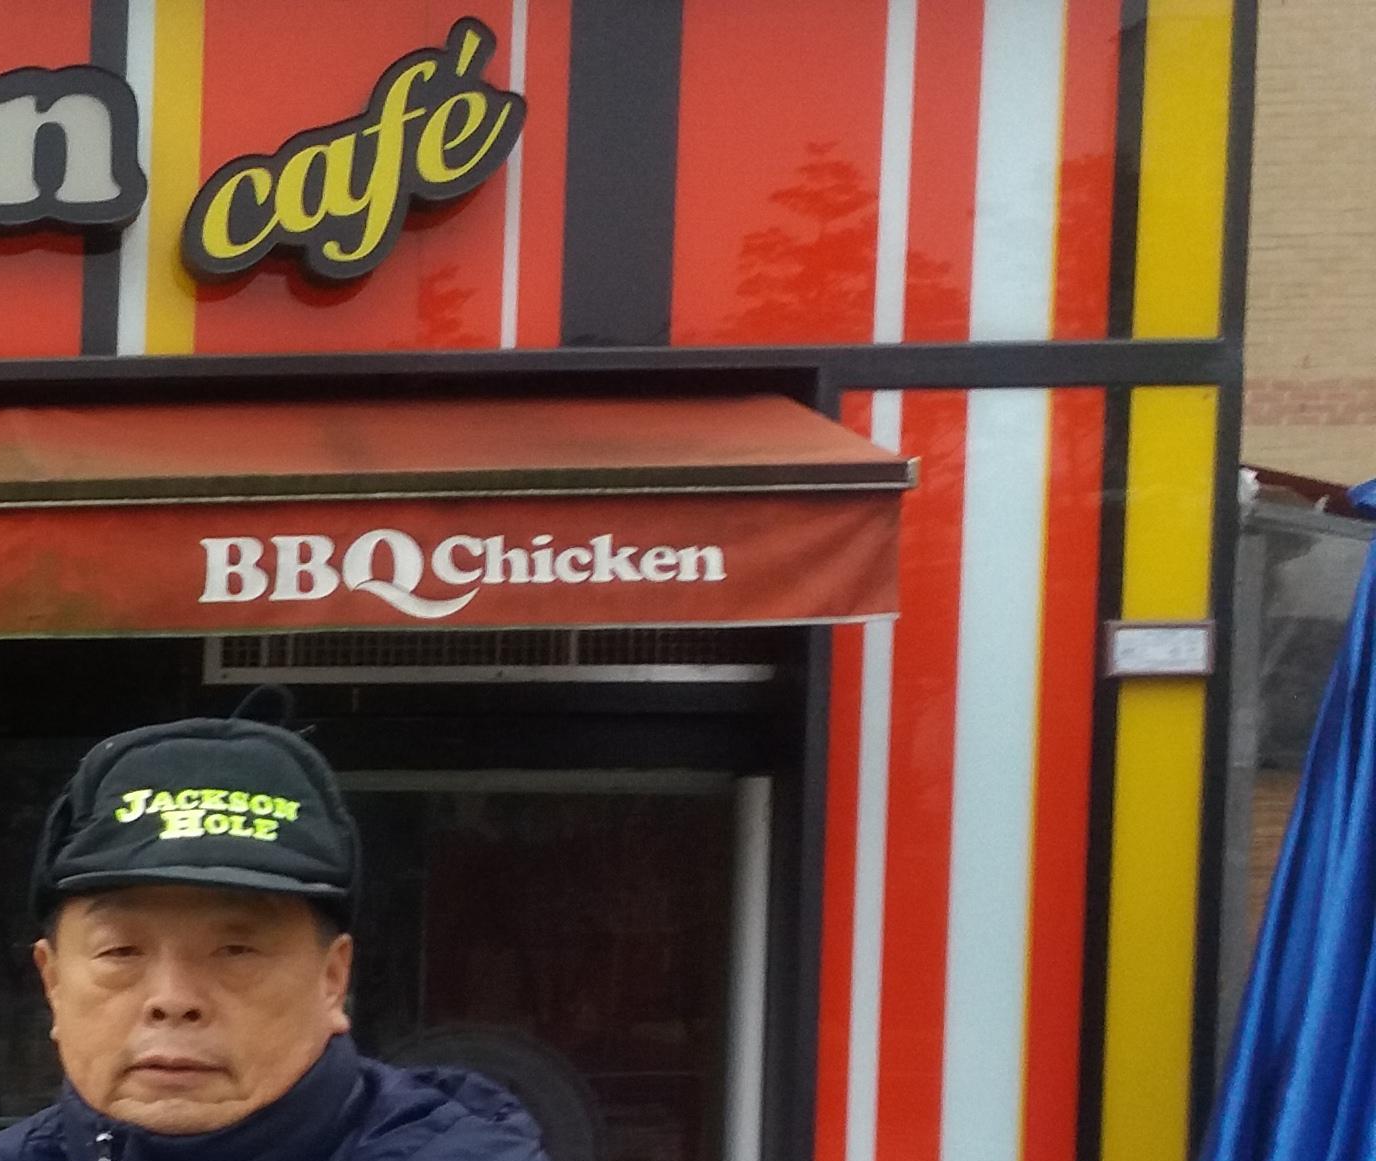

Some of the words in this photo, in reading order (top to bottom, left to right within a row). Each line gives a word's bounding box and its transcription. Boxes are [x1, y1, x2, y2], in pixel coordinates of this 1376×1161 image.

[200, 28, 512, 262] café
[199, 529, 479, 619] BBQ
[445, 533, 726, 587] Chicken
[114, 788, 301, 823] JACKSON
[159, 808, 279, 841] HOLE
